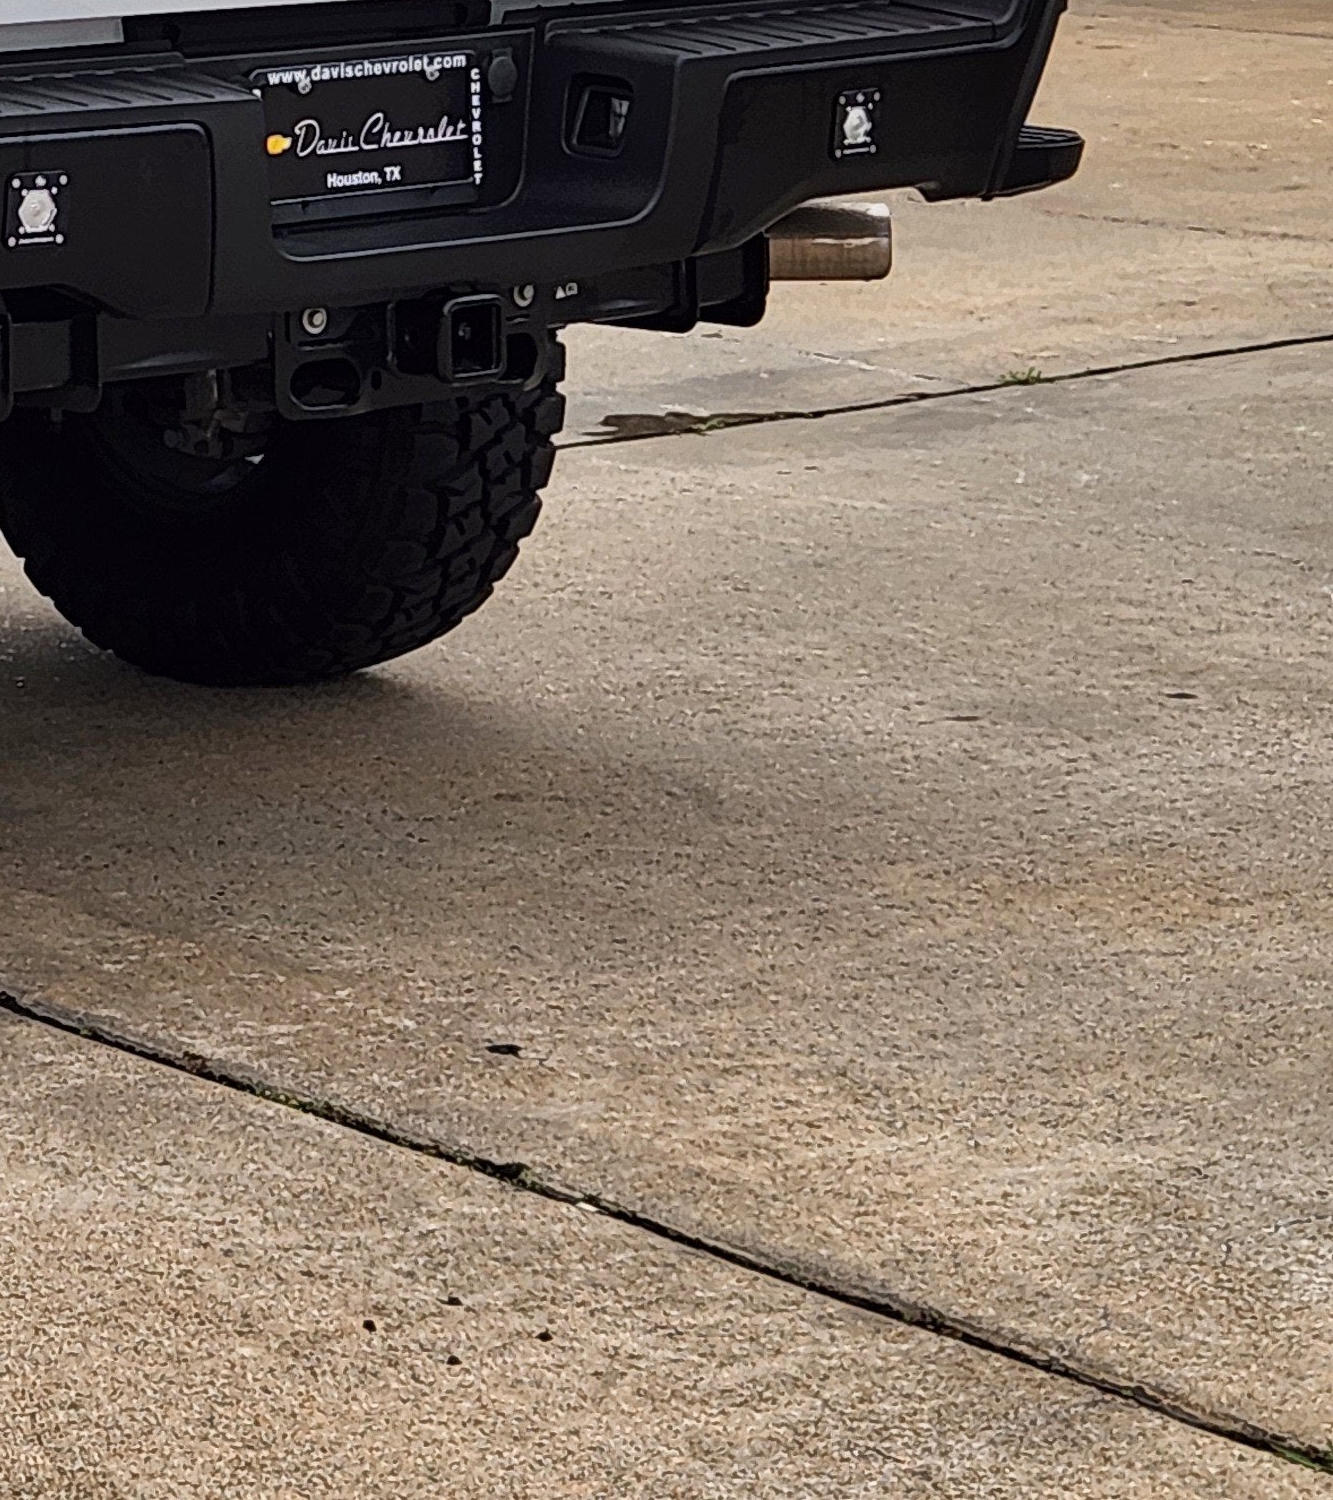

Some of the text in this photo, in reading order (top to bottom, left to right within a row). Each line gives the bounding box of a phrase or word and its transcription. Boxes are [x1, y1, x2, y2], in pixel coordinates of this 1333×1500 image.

[267, 54, 468, 86] www.davischevrolet.com
[294, 111, 469, 158] Davis Chevrolet
[470, 67, 483, 186] CHEVROLET
[326, 165, 402, 189] Houston, TX
